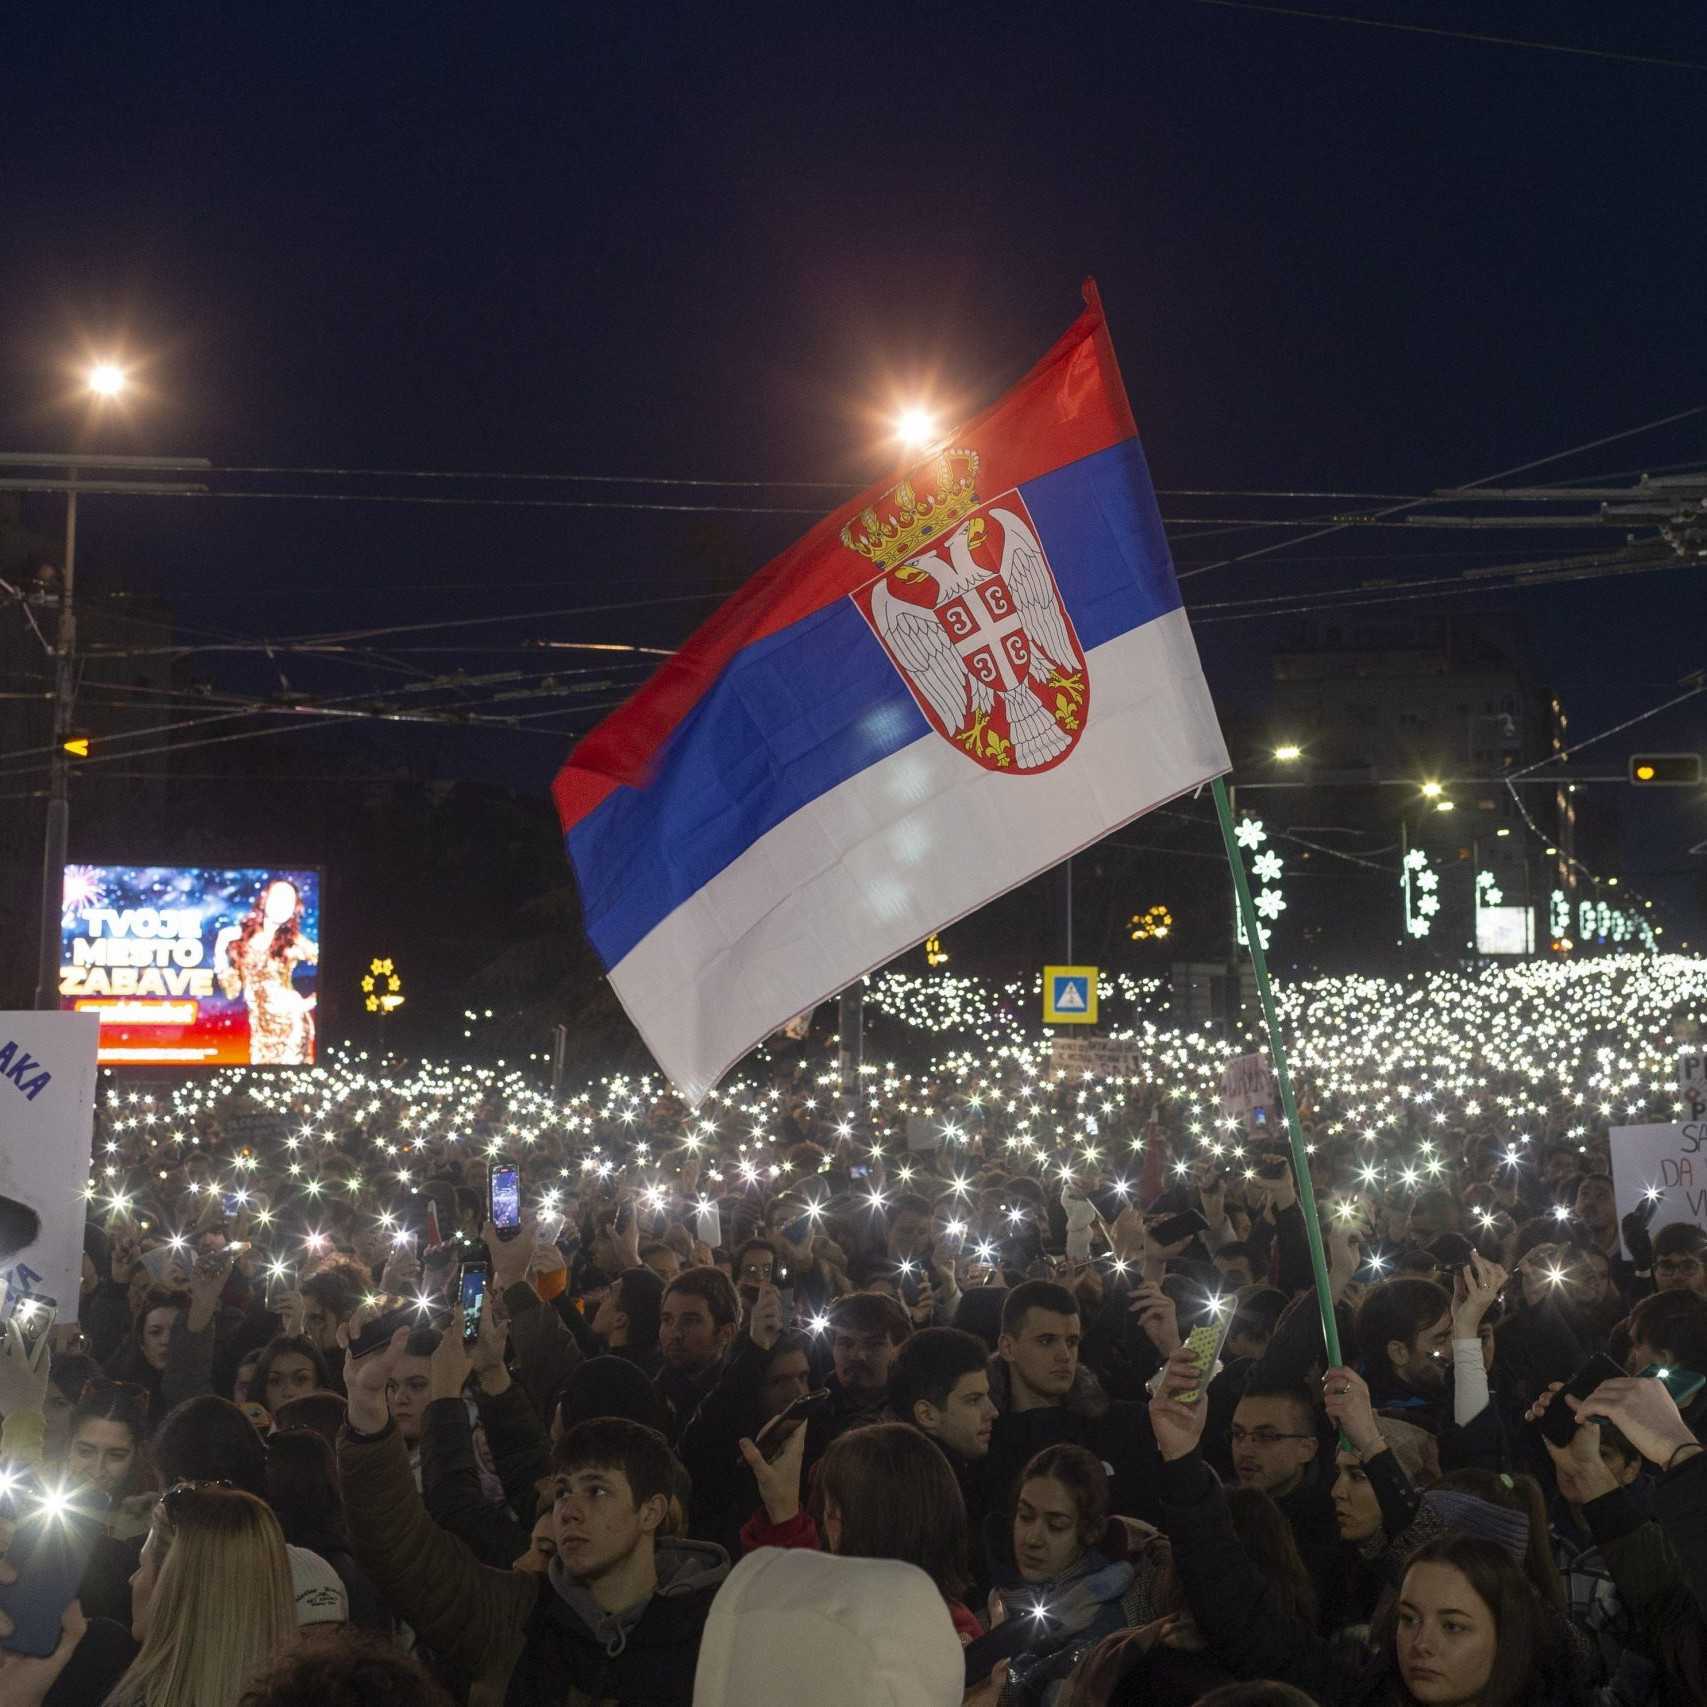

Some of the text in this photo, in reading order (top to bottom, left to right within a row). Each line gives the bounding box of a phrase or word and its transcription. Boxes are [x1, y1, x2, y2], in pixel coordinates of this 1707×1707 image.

[82, 908, 202, 937] TVOJE
[73, 938, 203, 967] MESTO
[59, 966, 214, 995] ZABAVE
[1661, 1158, 1693, 1187] DA
